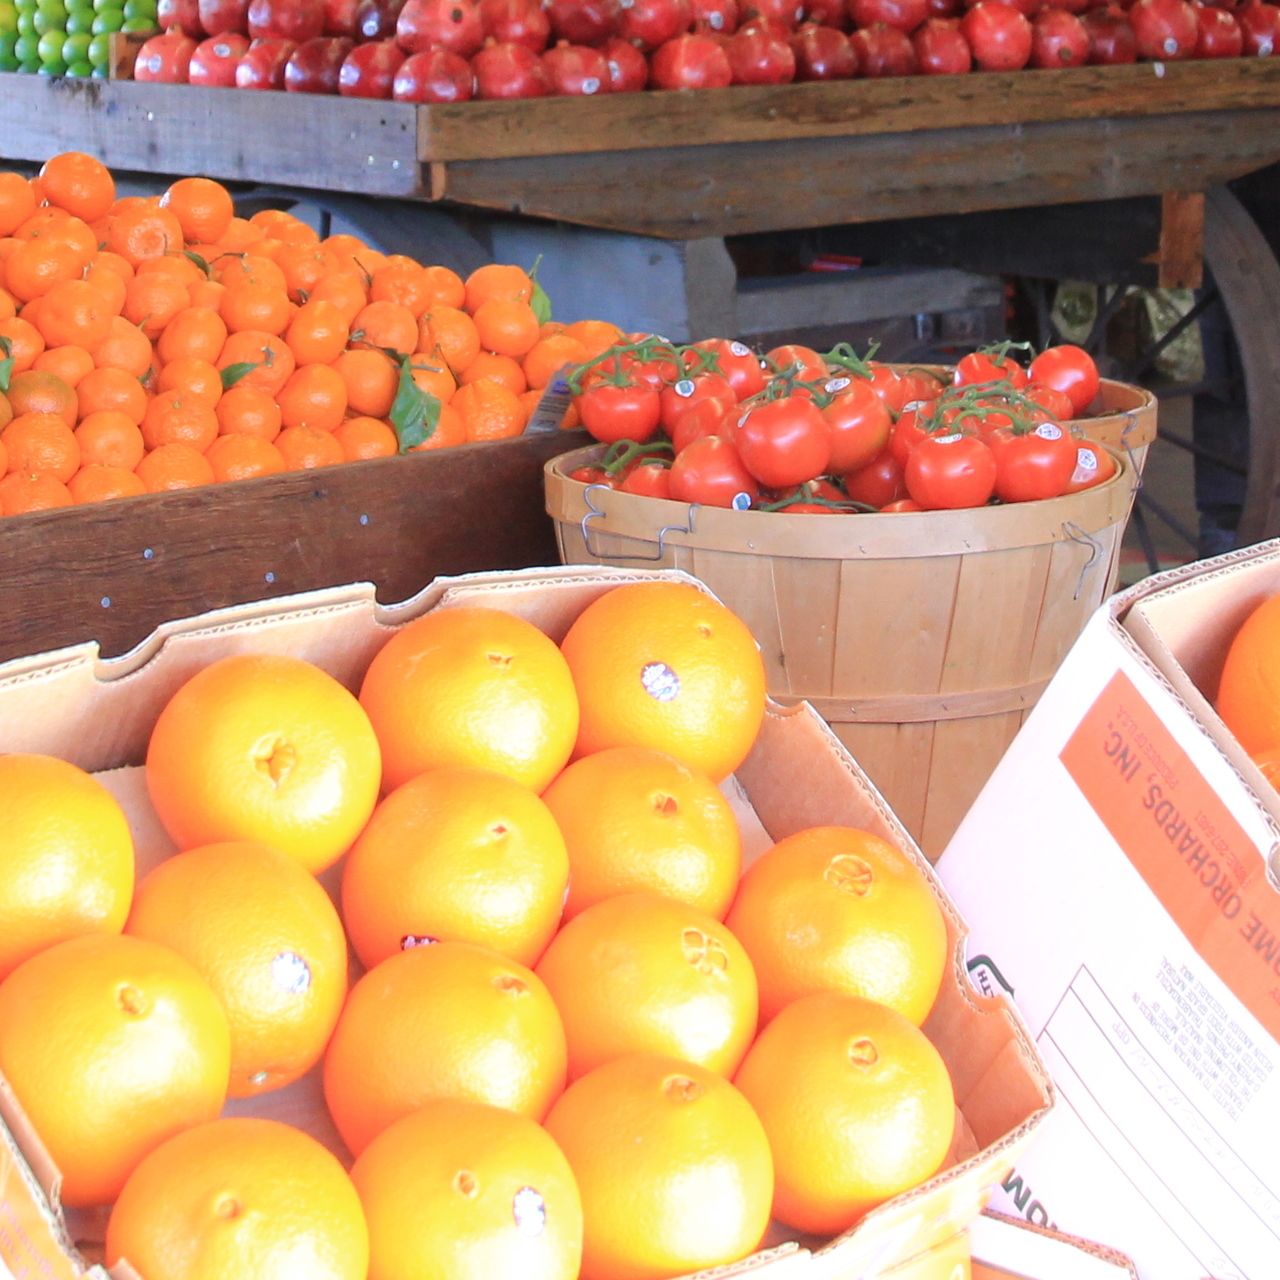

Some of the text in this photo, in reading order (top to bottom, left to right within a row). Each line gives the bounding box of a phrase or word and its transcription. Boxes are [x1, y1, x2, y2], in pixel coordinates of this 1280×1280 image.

[1100, 720, 1143, 779] INC.
[1131, 729, 1149, 750] OF
[1143, 744, 1179, 789] PRODUCE
[1140, 771, 1244, 920] ORCHARDS,
